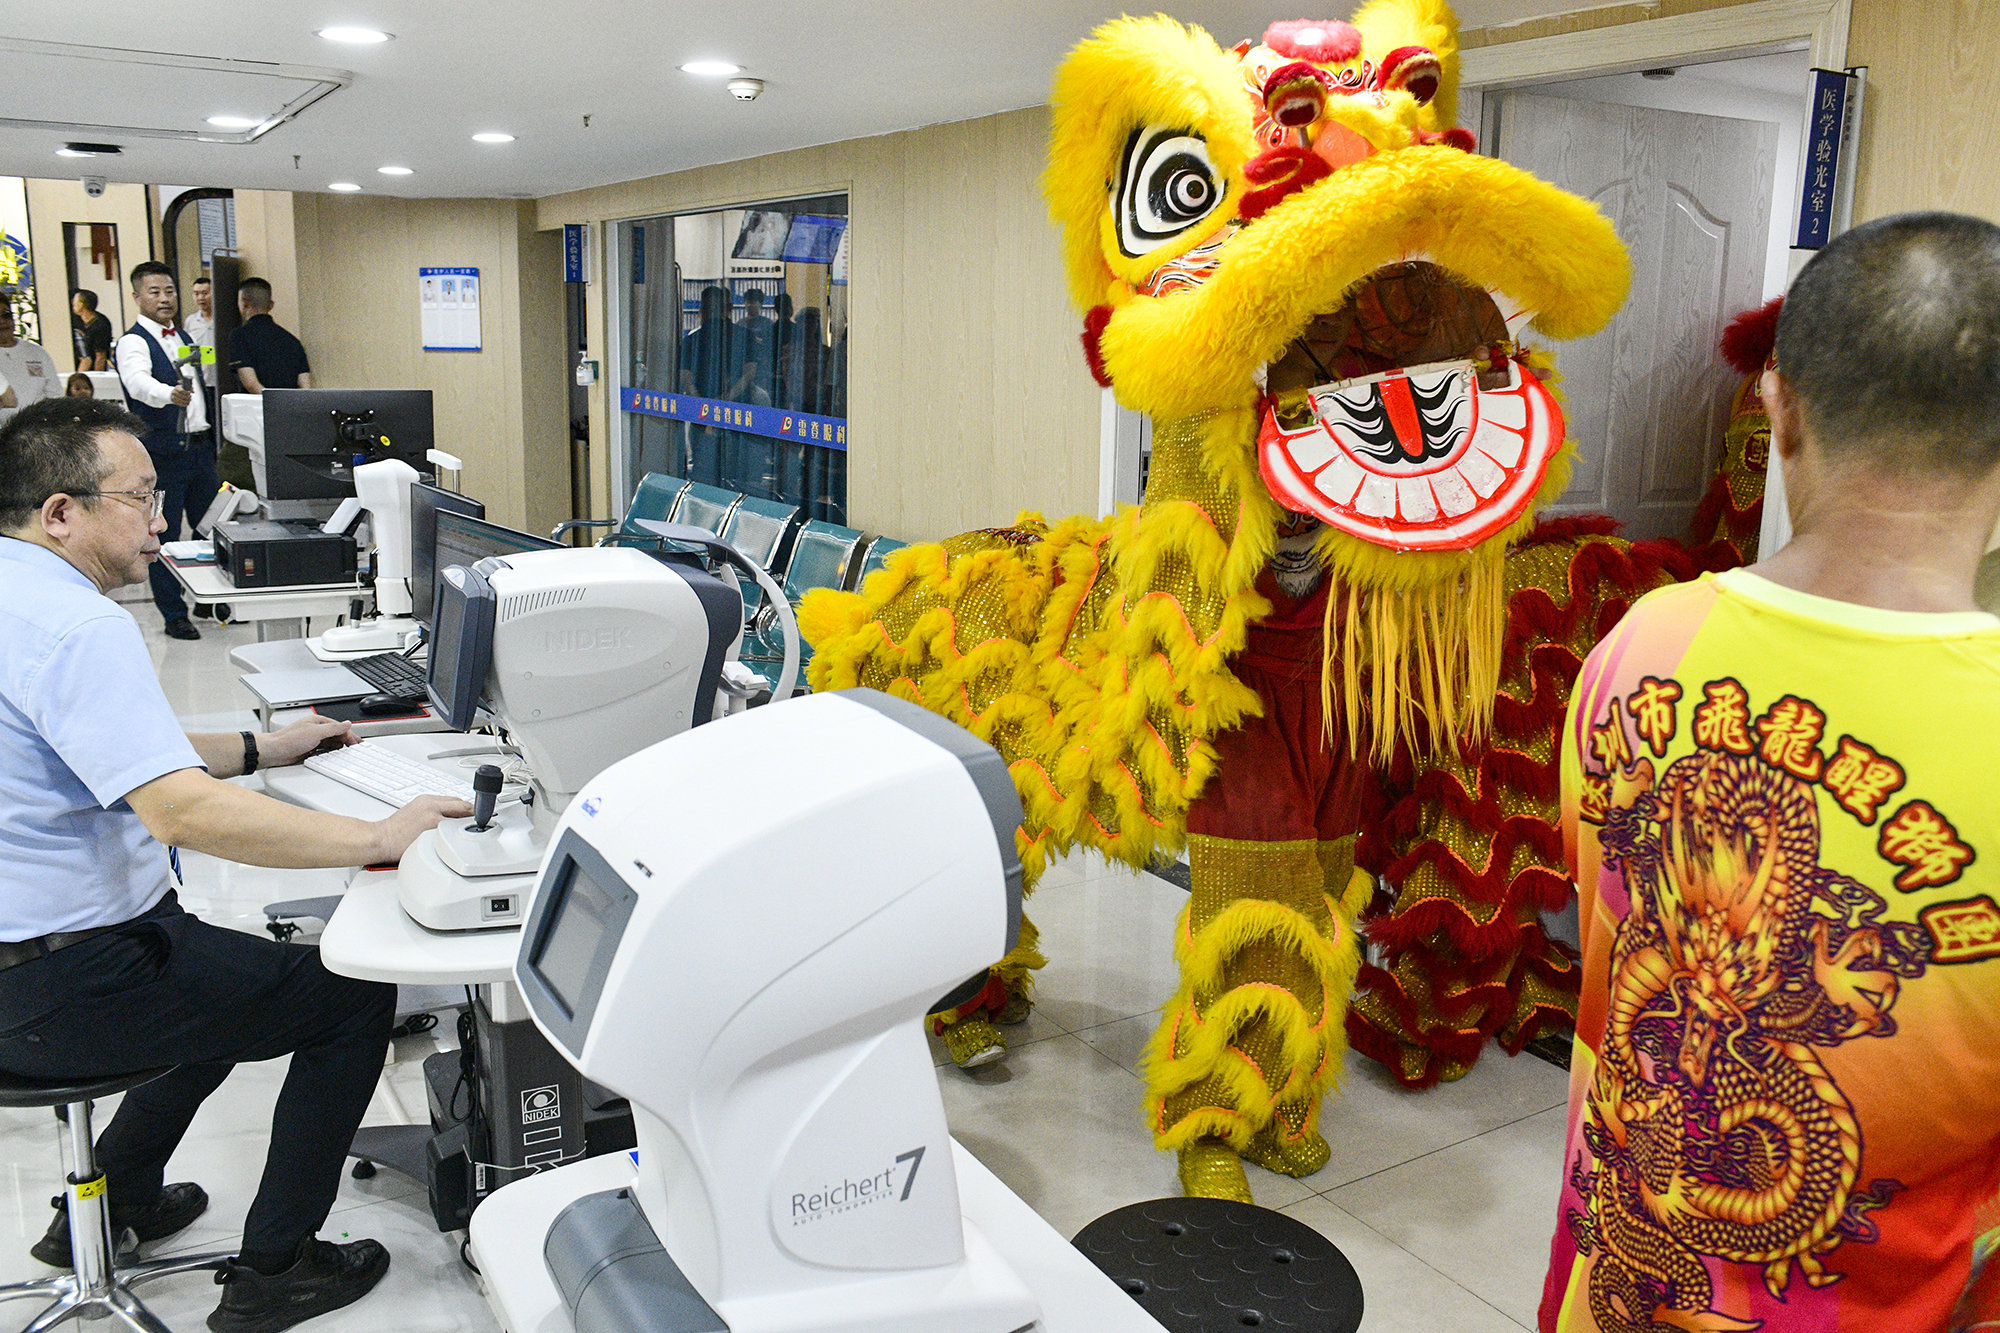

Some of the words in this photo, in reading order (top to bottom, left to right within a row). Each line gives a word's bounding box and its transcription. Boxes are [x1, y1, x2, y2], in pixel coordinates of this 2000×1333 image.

[1810, 87, 1838, 236] 医学验光室2
[713, 405, 753, 428] 雷登眼科
[798, 418, 846, 445] 雷登眼科
[545, 626, 635, 653] NIDEK
[525, 1107, 558, 1122] NIDEK
[895, 1145, 926, 1202] 7
[792, 1213, 823, 1227] AUTO
